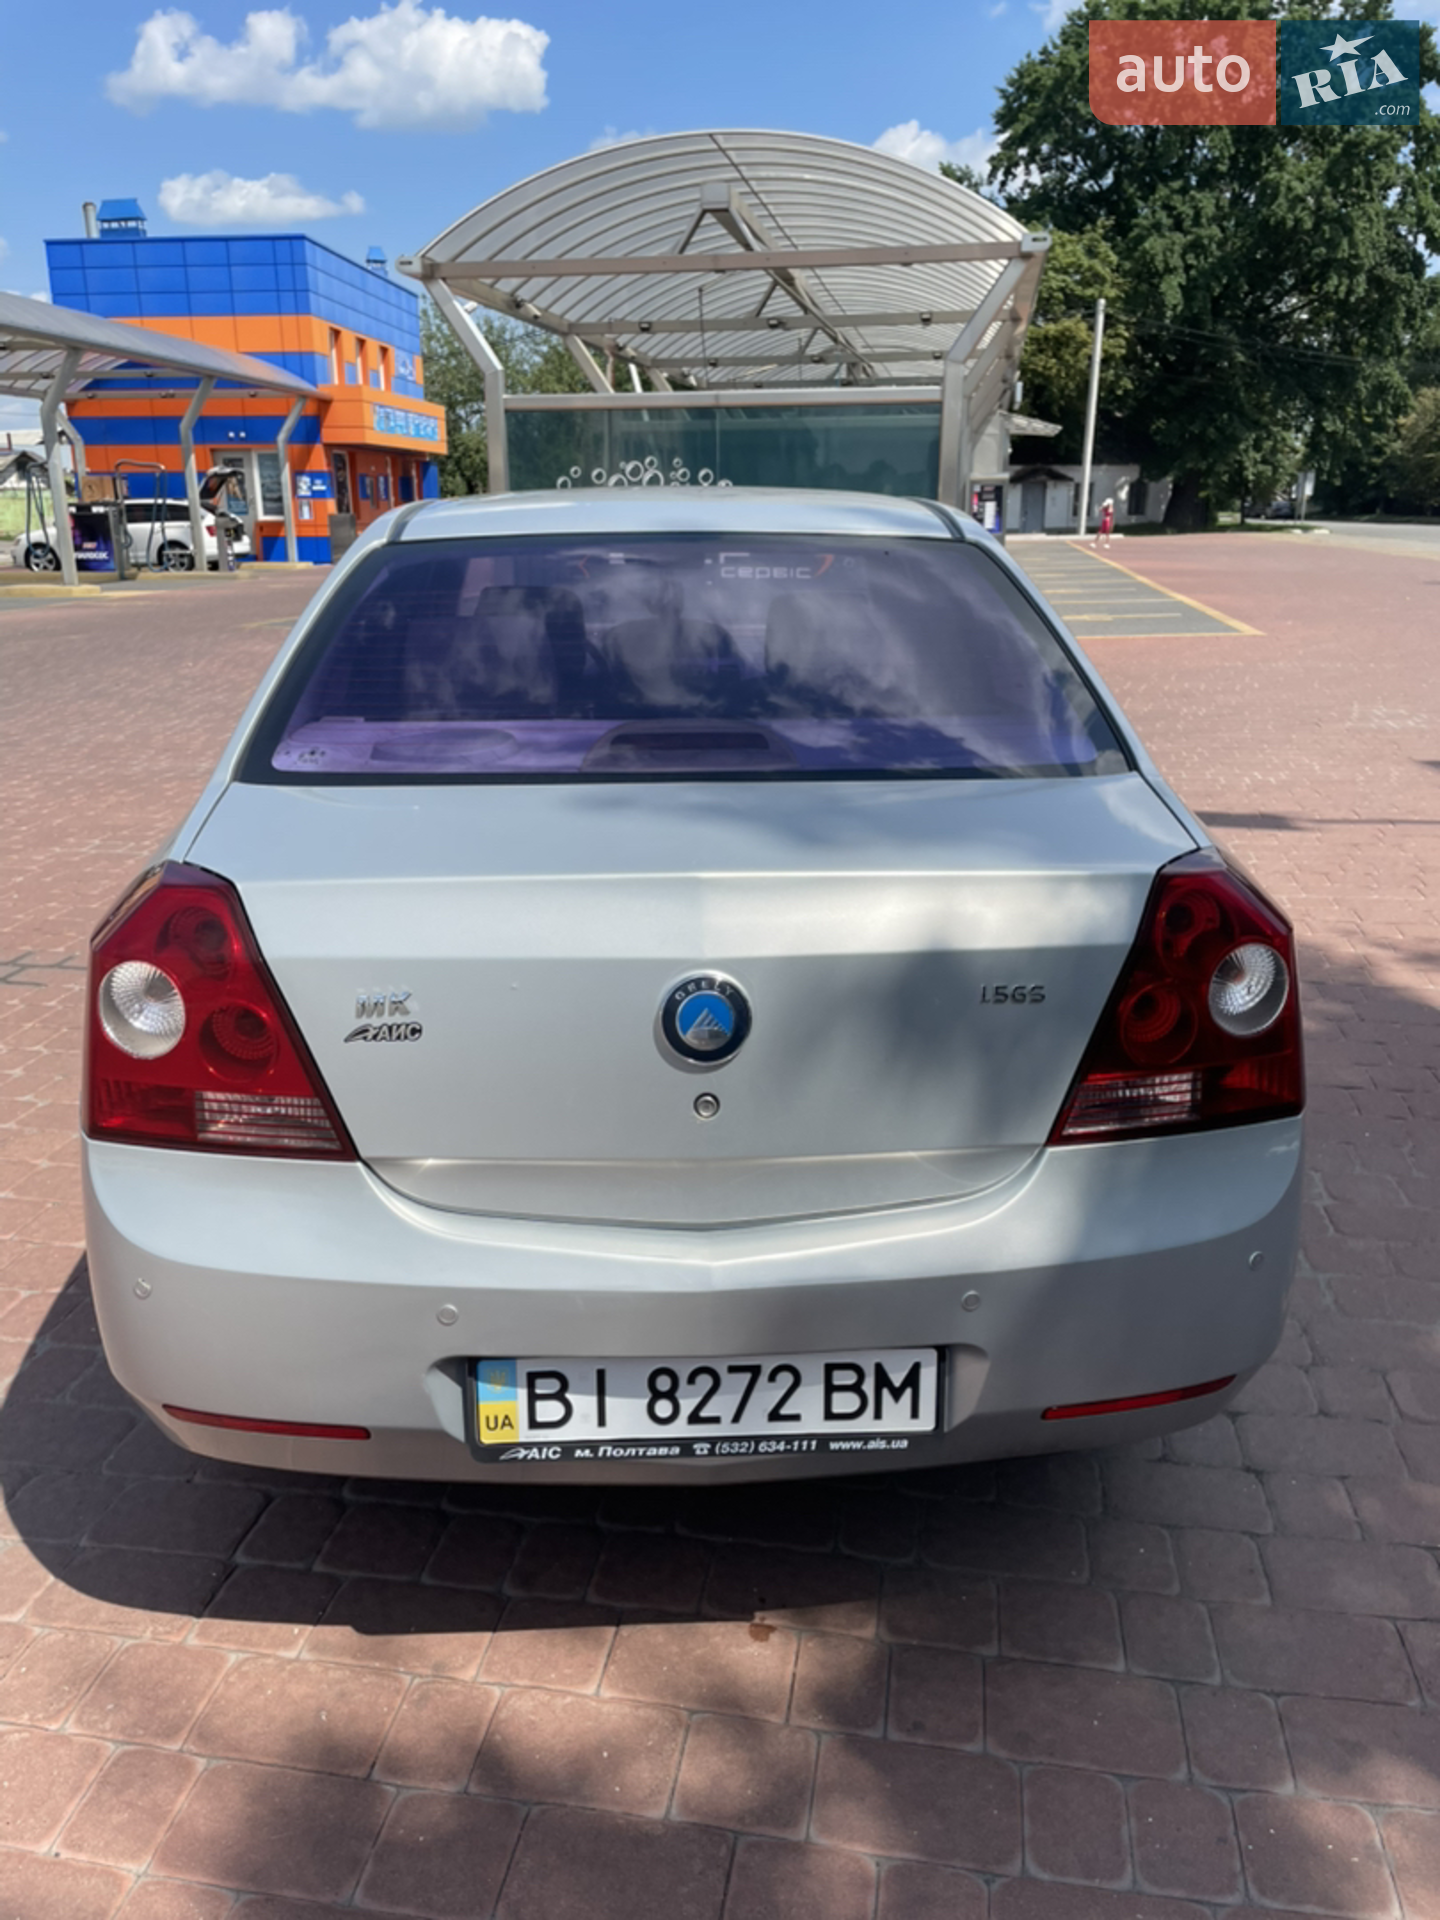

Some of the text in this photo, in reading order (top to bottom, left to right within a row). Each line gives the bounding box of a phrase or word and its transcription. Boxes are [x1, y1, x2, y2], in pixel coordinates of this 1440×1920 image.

[355, 991, 412, 1019] MK
[646, 1363, 803, 1427] 8272
[822, 1360, 922, 1422] BM
[484, 1414, 515, 1432] UA
[598, 1445, 681, 1458] Полтава
[714, 1441, 756, 1455] (532)
[758, 1438, 818, 1454] 634-111
[828, 1436, 909, 1451] www.ais.ua
